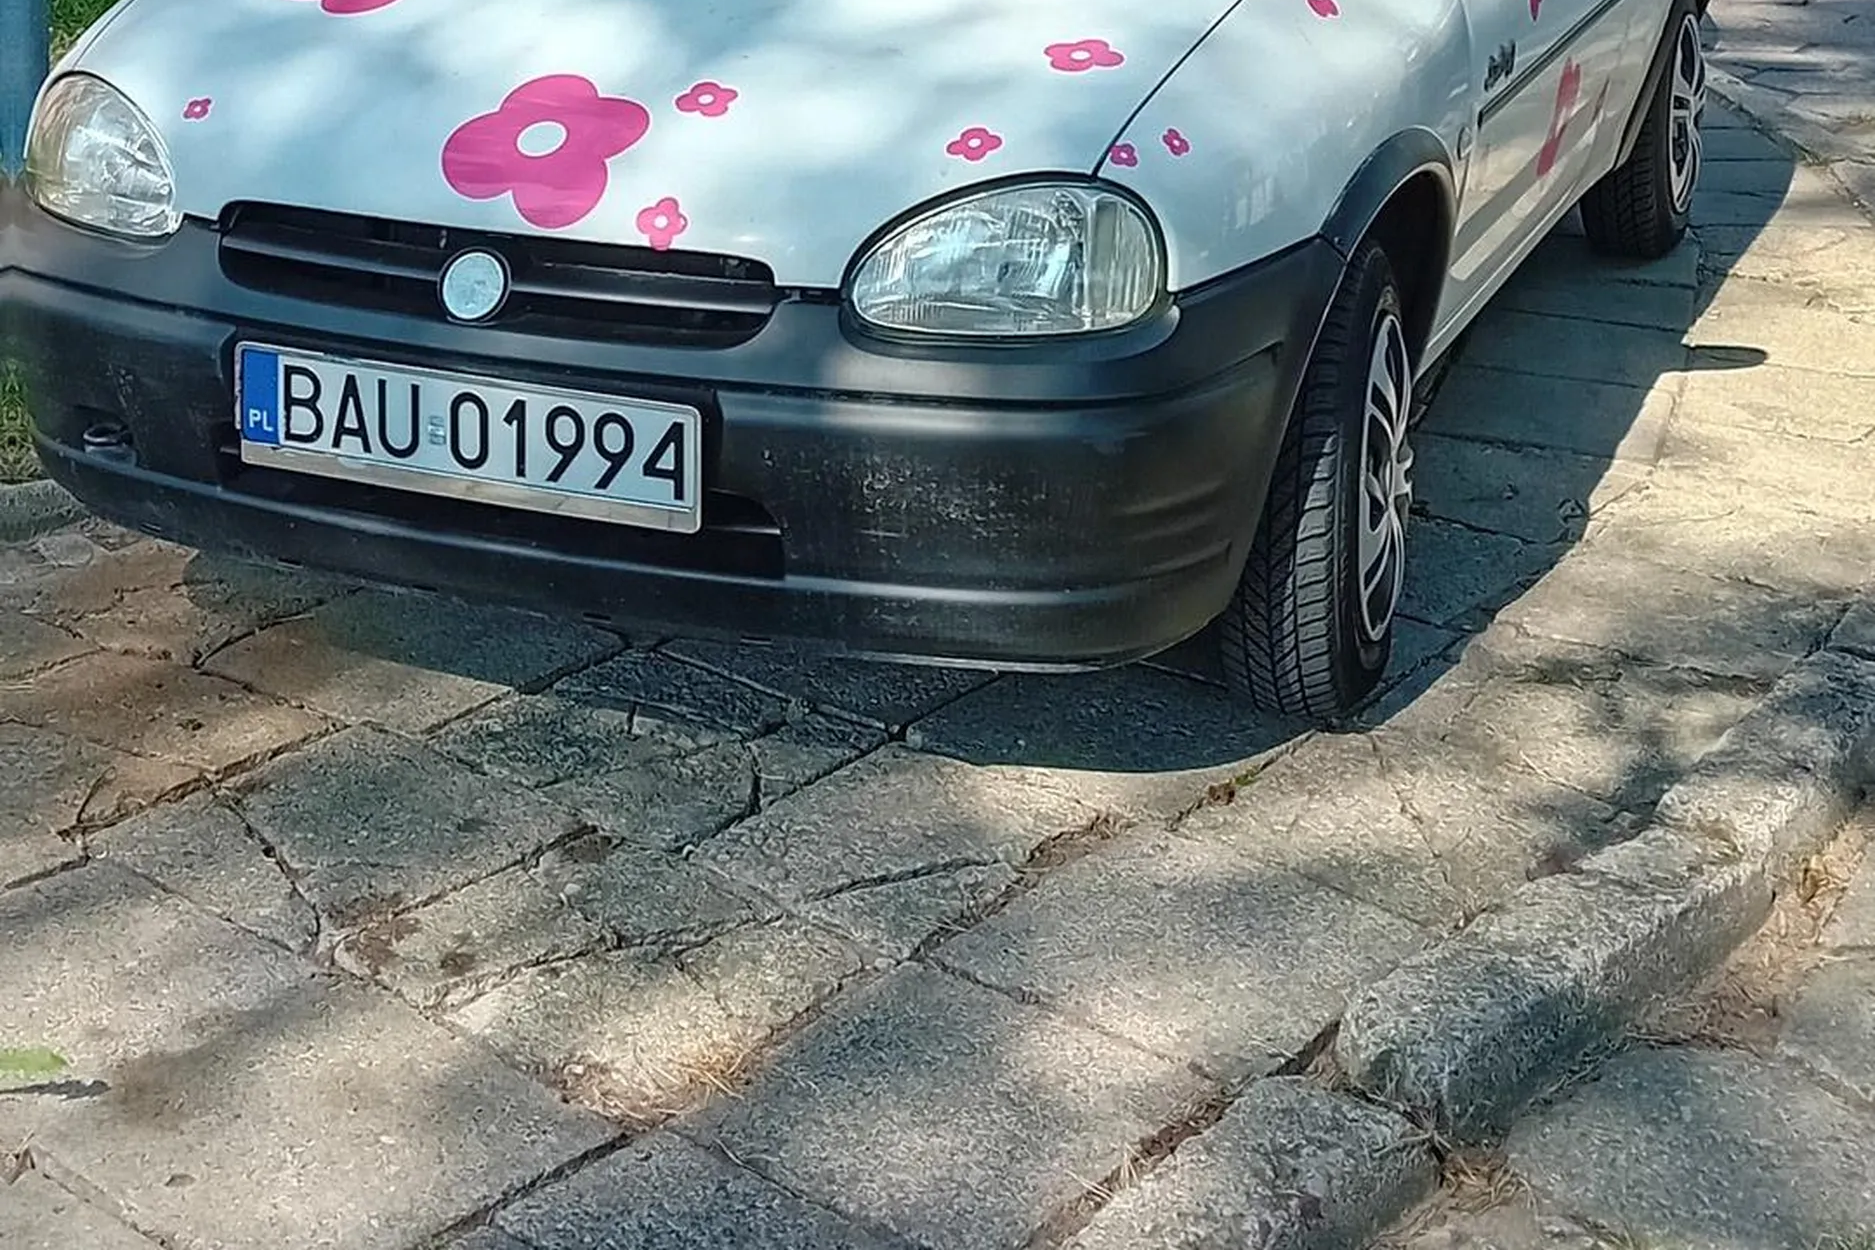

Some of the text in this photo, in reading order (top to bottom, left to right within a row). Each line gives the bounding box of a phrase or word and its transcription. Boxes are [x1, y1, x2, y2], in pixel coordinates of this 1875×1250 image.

[249, 408, 275, 432] PL
[284, 365, 686, 501] BAU 01994
